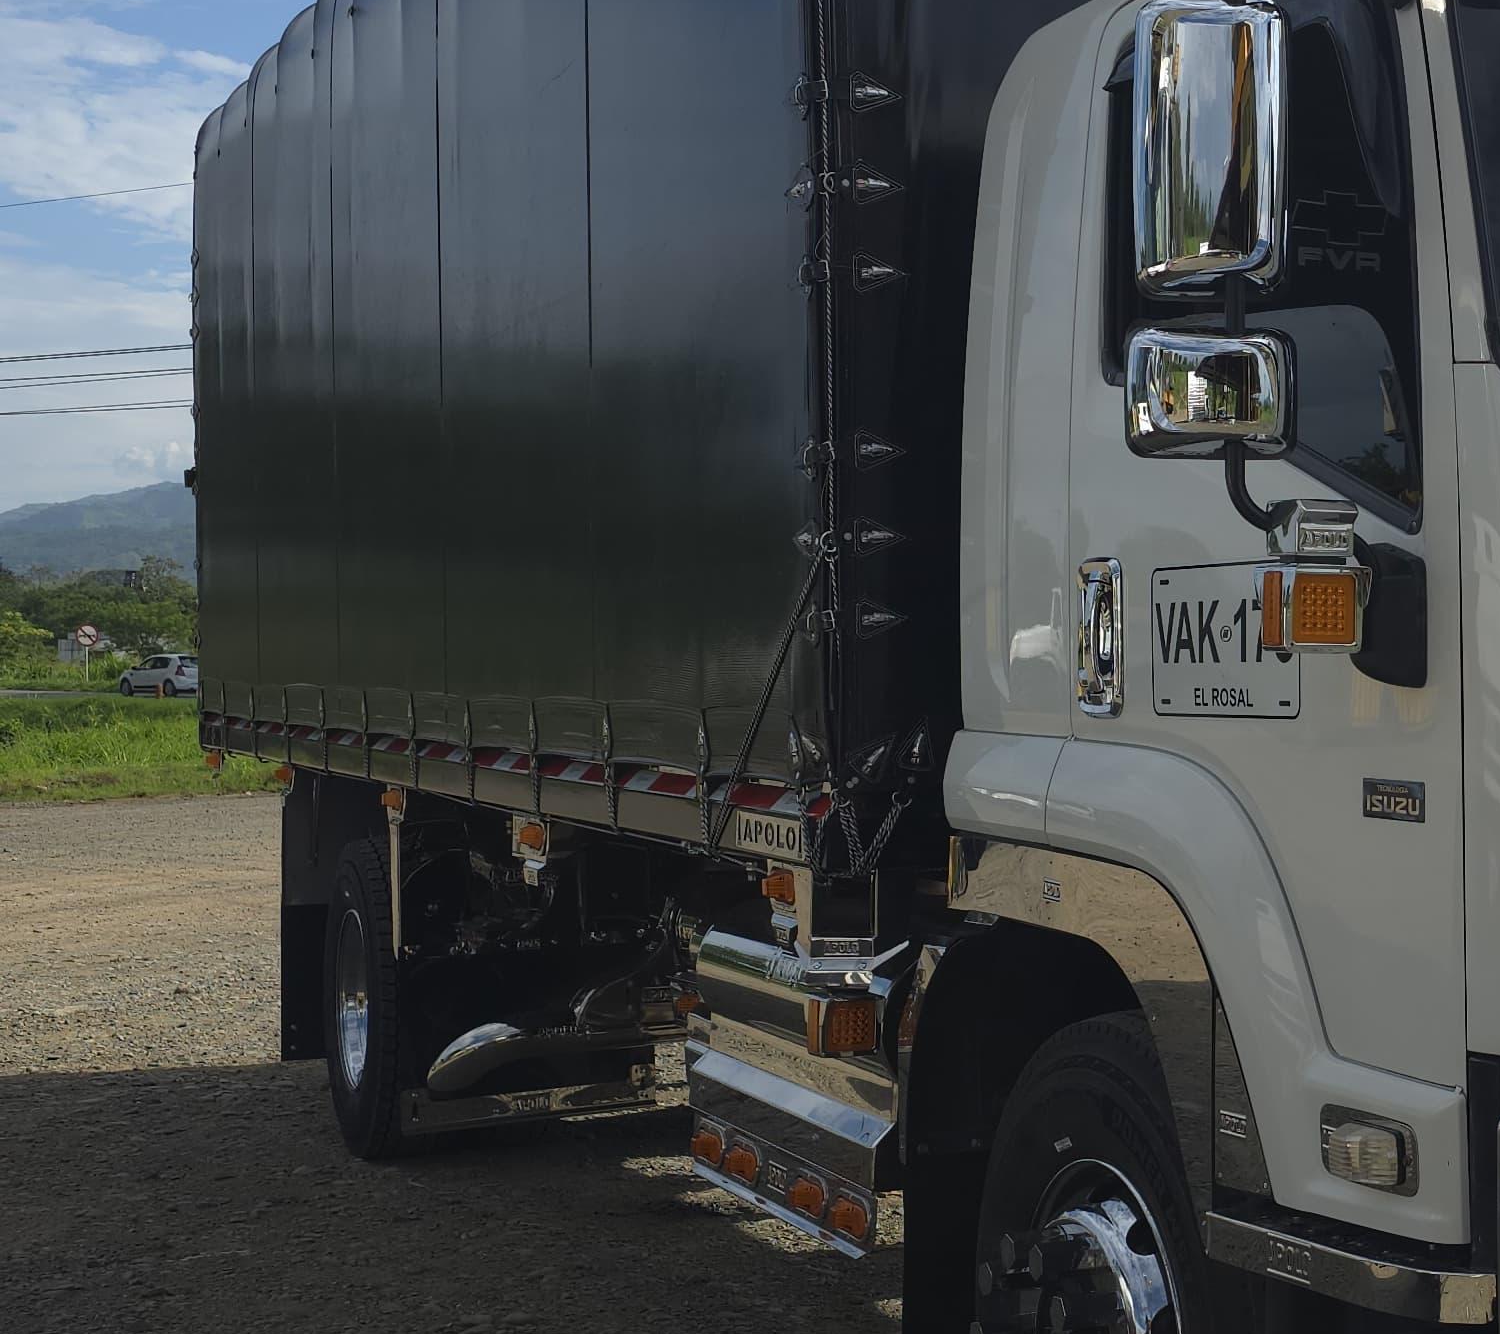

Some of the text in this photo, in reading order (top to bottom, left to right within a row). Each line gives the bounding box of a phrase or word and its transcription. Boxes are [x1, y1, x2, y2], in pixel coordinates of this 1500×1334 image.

[1297, 246, 1381, 272] FVR
[1193, 687, 1254, 708] EL ROSAL
[1366, 794, 1420, 816] ISUZU
[743, 818, 796, 851] APOLO
